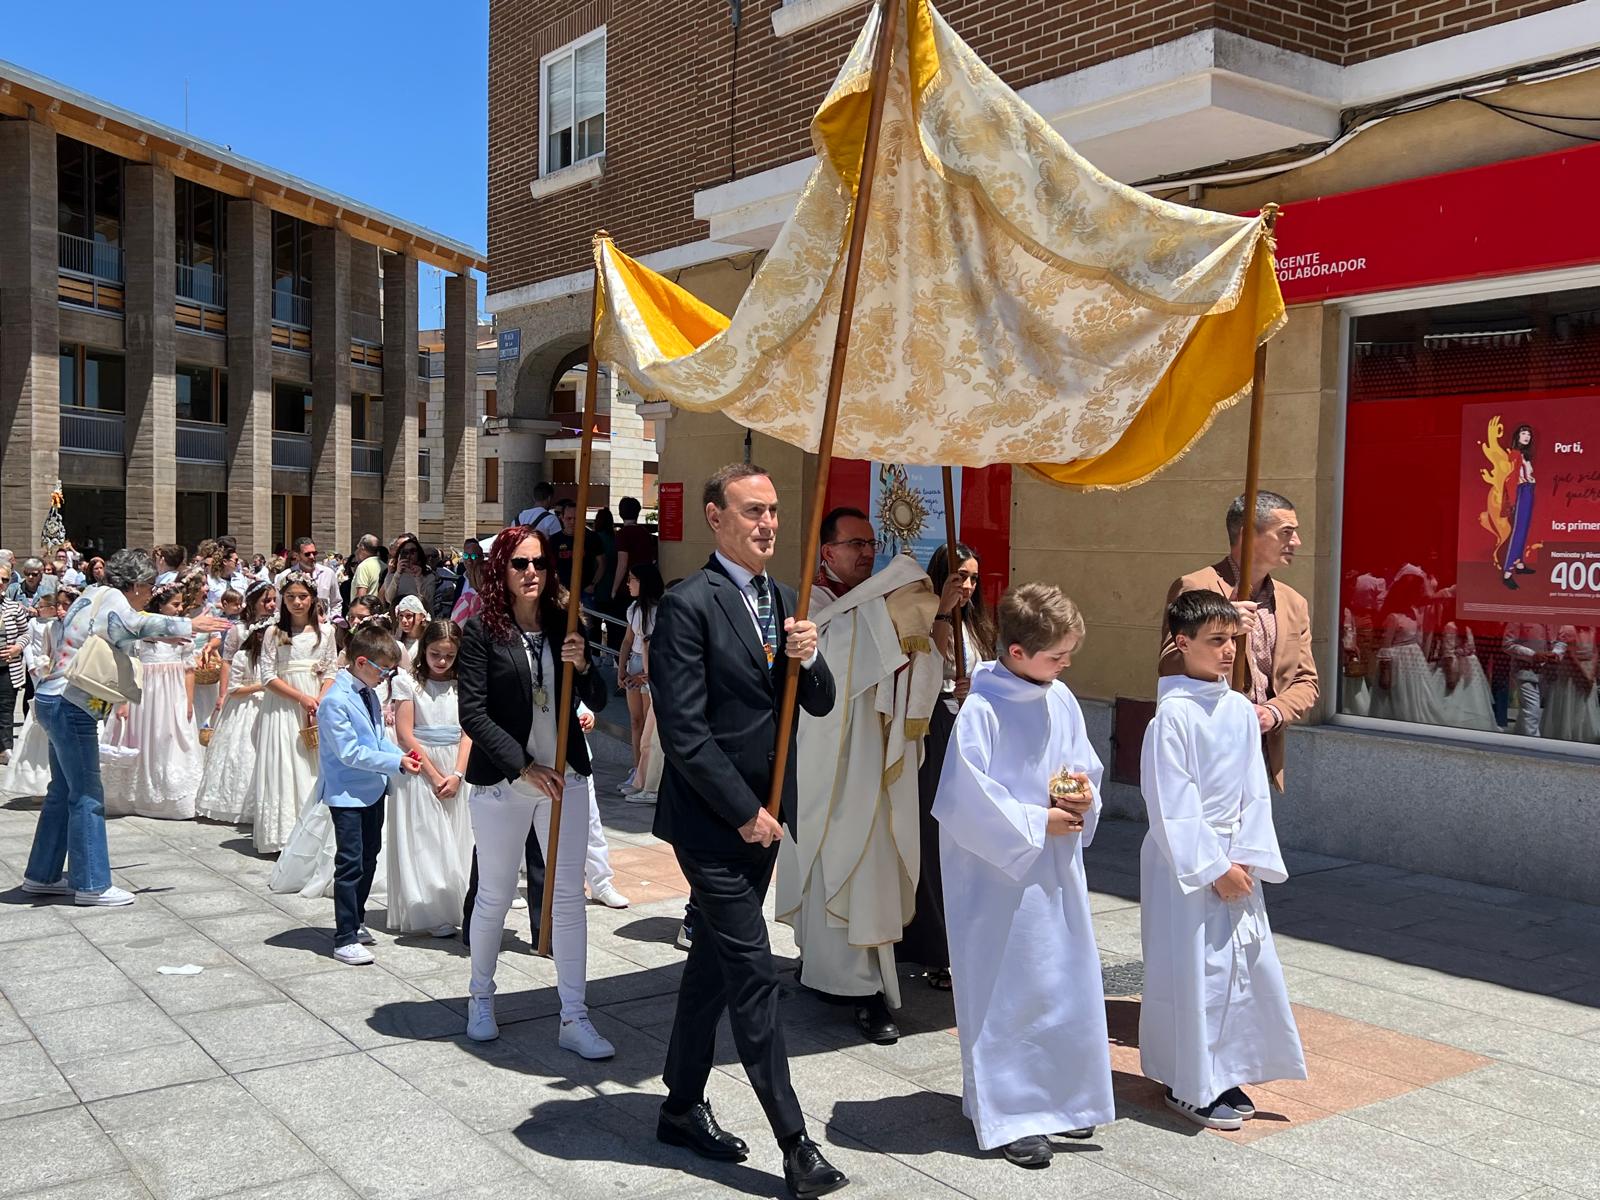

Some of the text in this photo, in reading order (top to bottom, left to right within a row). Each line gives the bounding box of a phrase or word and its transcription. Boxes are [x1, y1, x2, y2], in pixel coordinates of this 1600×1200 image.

[1274, 252, 1320, 269] AGENTE
[1554, 441, 1583, 454] Por ti,
[1552, 520, 1567, 530] los
